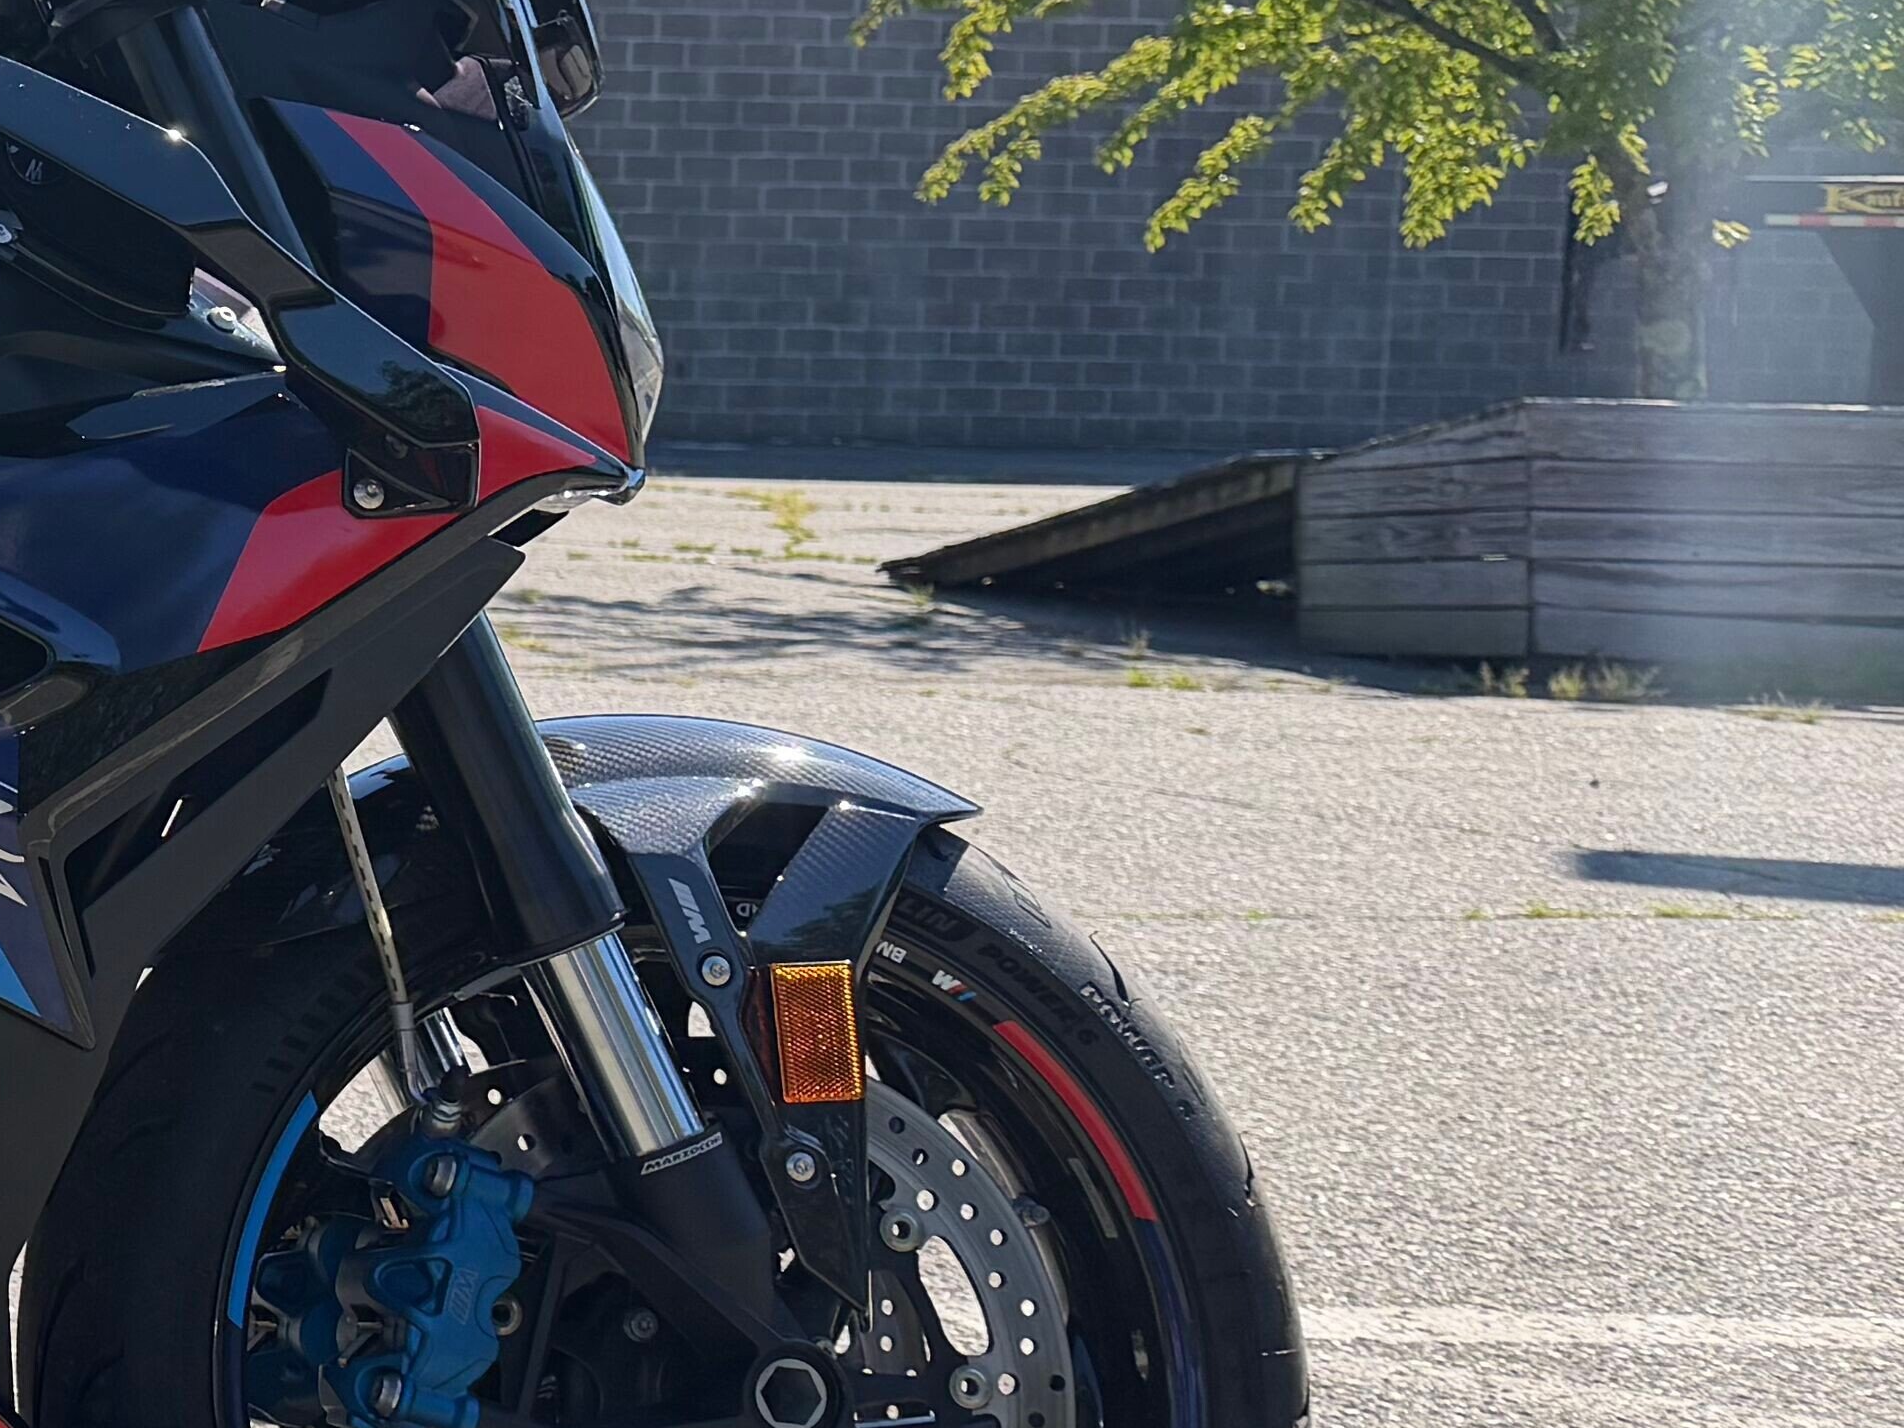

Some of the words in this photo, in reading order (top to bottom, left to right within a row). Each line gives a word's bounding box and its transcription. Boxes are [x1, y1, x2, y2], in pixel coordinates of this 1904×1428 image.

[978, 940, 1081, 1035] POWER
[1078, 1026, 1099, 1046] 6
[1079, 980, 1176, 1089] POWER
